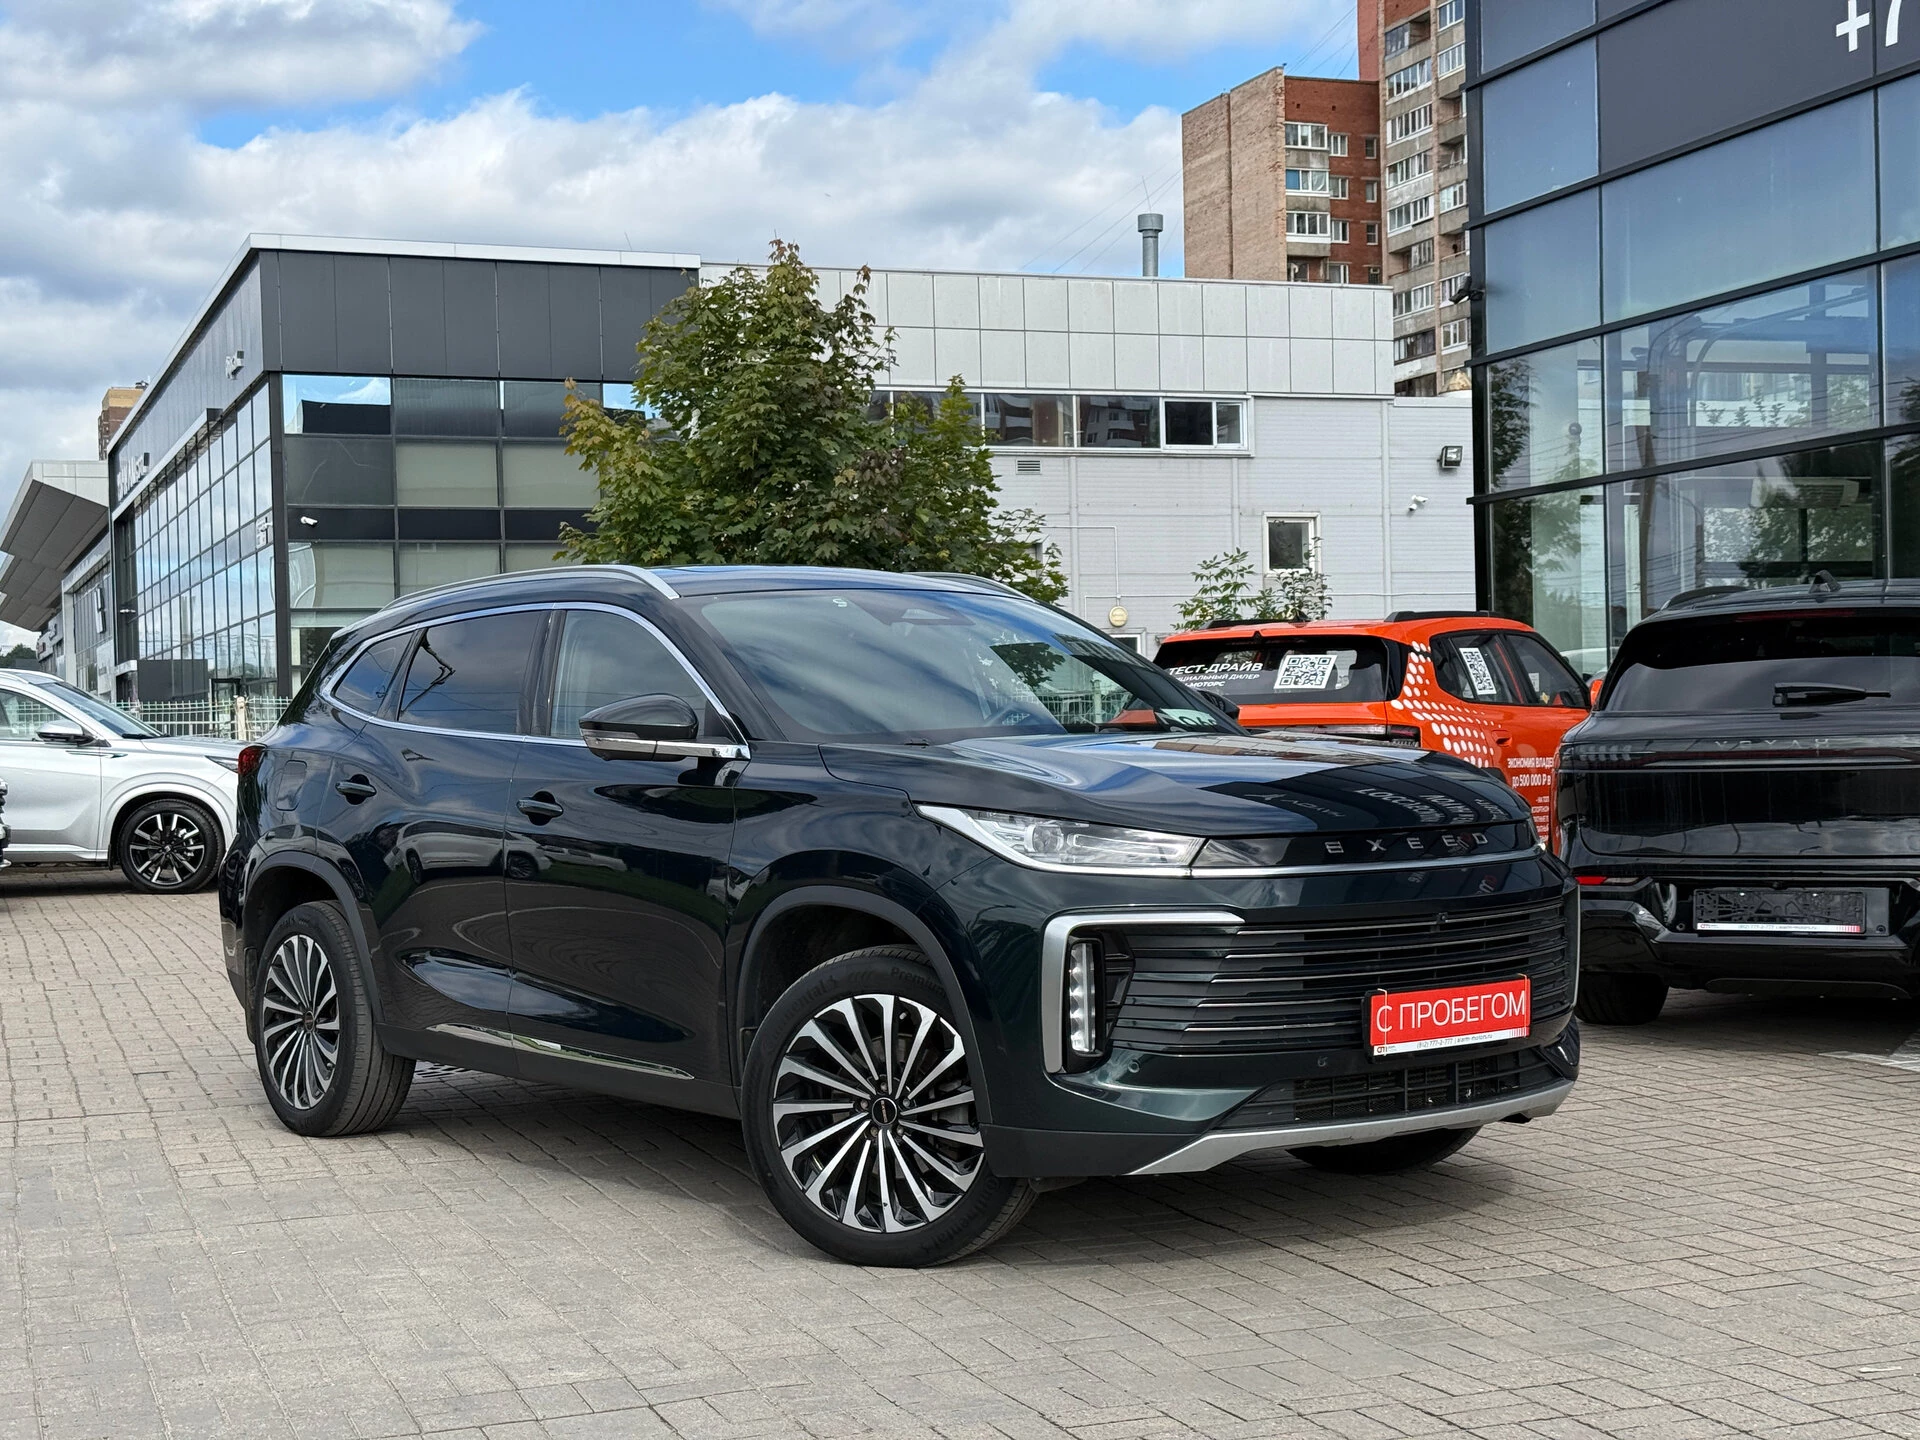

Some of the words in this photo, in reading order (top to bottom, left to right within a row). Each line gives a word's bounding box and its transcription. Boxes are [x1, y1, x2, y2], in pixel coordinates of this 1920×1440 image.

[1169, 661, 1264, 676] ТЕСТ-ДРАЙВ
[1507, 757, 1535, 769] ЭКОНОМИЯ
[1520, 773, 1530, 787] 500
[1530, 773, 1541, 787] 000
[1325, 832, 1488, 854] EXEED
[1376, 1005, 1393, 1032] С
[1399, 990, 1526, 1031] ПРОБЕГОМ
